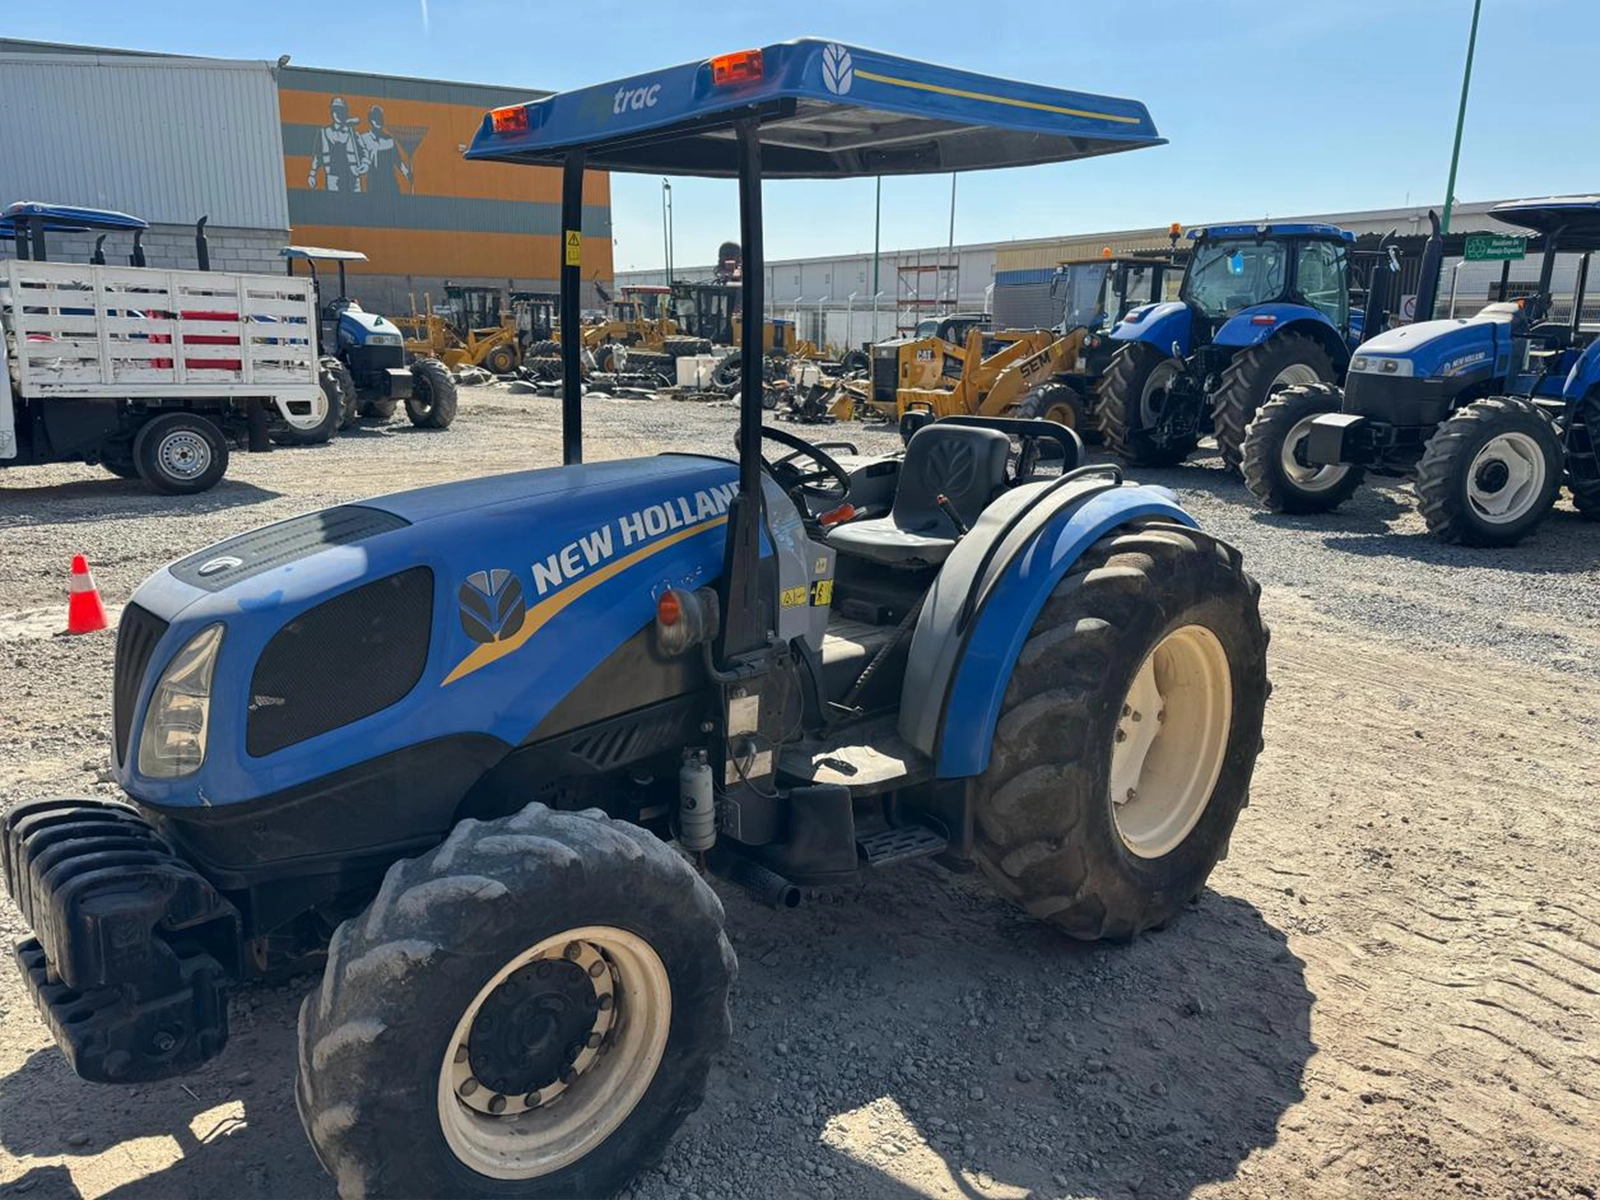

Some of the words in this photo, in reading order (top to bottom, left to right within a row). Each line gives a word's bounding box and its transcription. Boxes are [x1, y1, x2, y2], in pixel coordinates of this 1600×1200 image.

[916, 349, 933, 362] CAT
[1019, 351, 1051, 379] SEM
[531, 524, 614, 596] NEW
